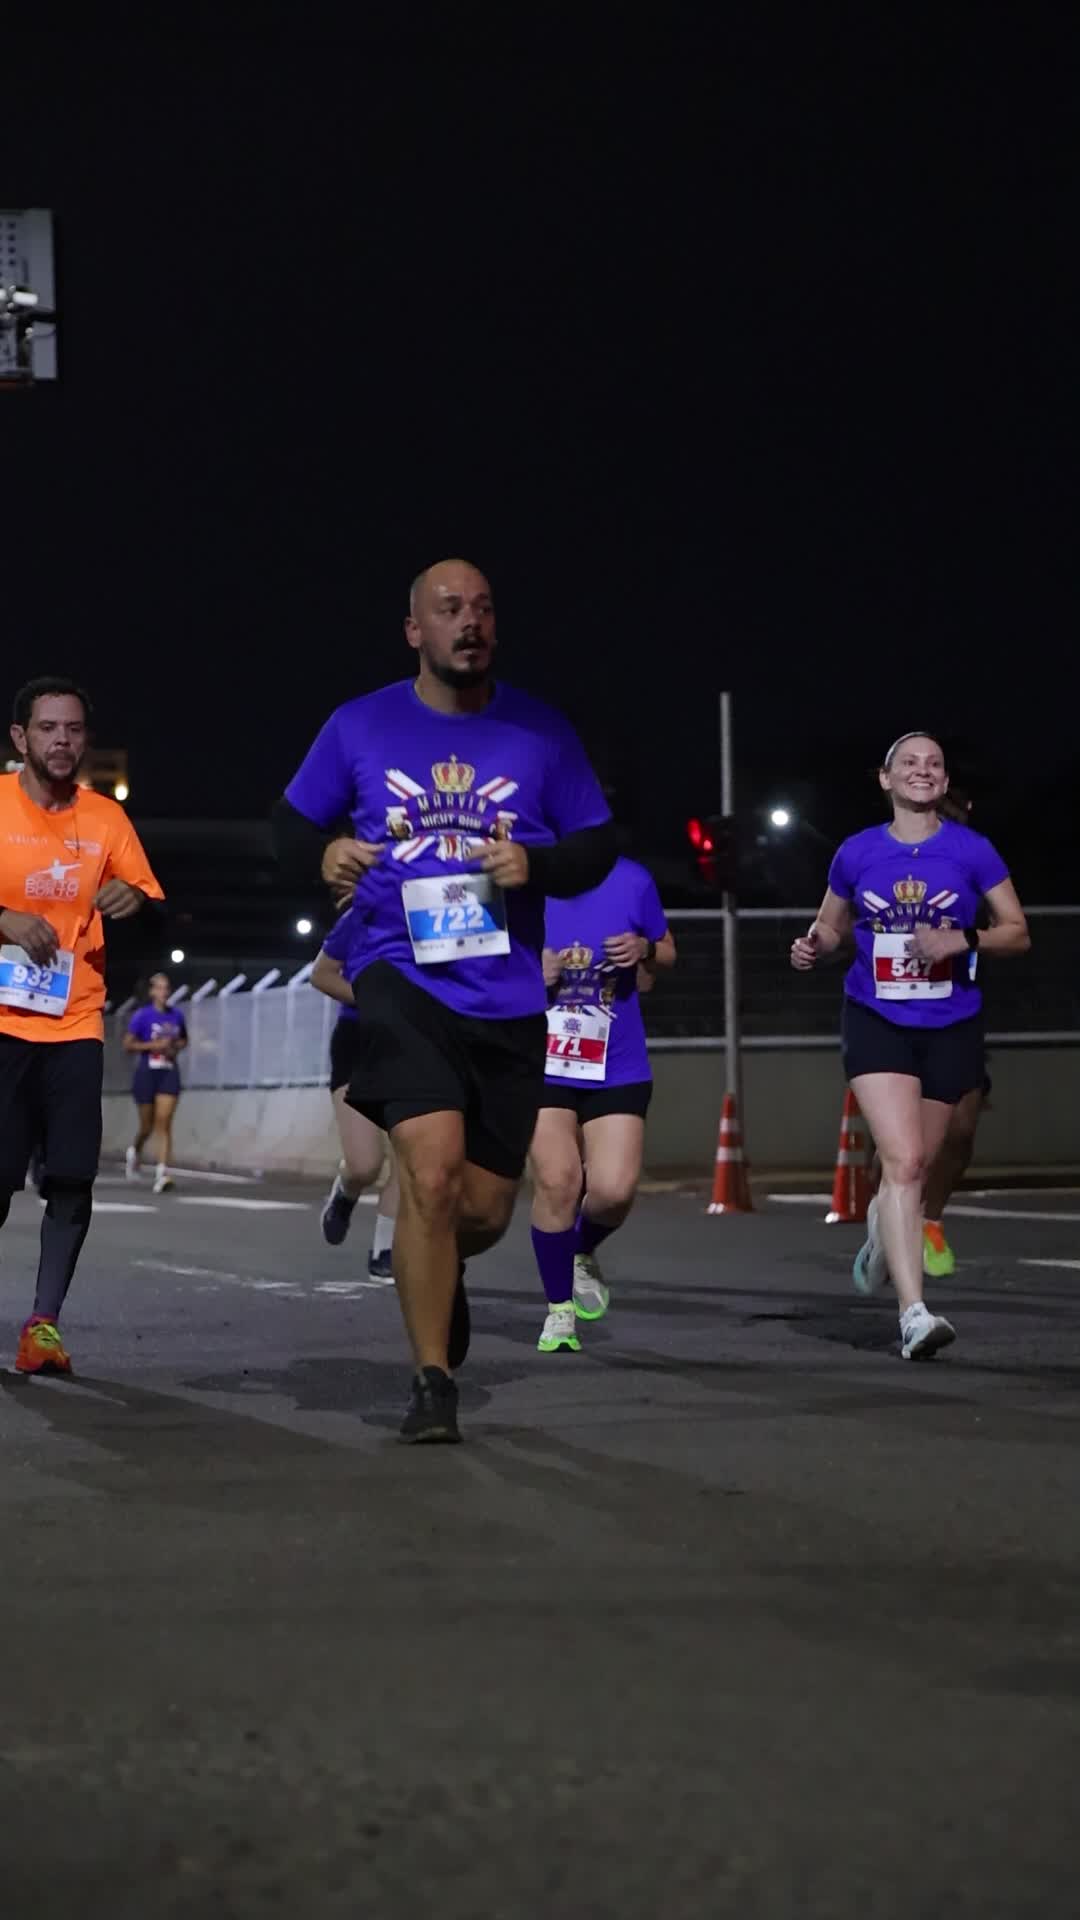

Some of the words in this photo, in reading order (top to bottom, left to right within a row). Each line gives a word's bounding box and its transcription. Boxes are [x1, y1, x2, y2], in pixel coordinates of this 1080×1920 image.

[416, 792, 487, 814] MARVIN
[420, 813, 456, 828] NIGHT
[427, 903, 485, 933] 722
[13, 964, 53, 991] 932
[891, 958, 934, 978] 547
